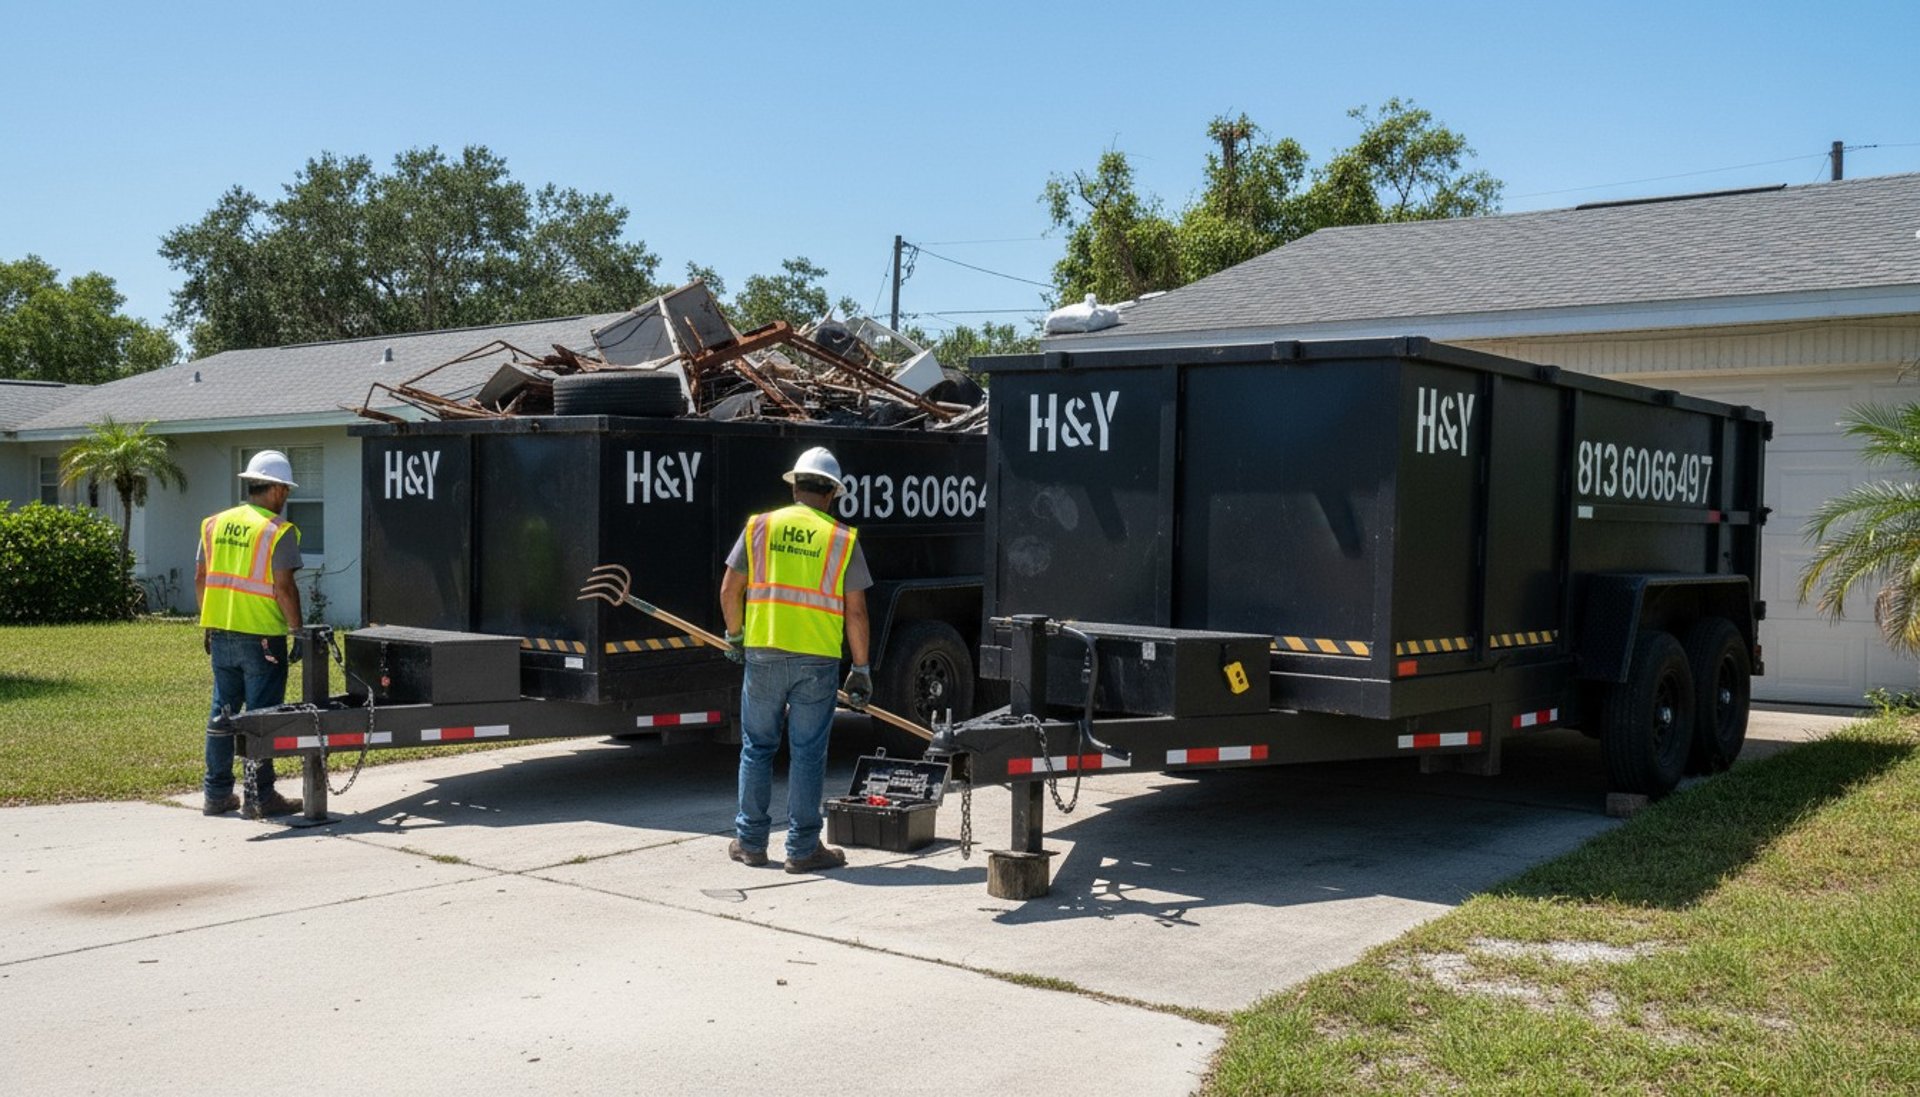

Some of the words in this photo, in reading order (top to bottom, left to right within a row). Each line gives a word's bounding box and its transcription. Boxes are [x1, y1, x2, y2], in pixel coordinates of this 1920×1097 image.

[1030, 391, 1119, 452] H&Y
[1416, 387, 1475, 457] H&Y
[384, 451, 441, 499] H&Y
[627, 451, 702, 503] H&Y
[838, 474, 894, 518] 813
